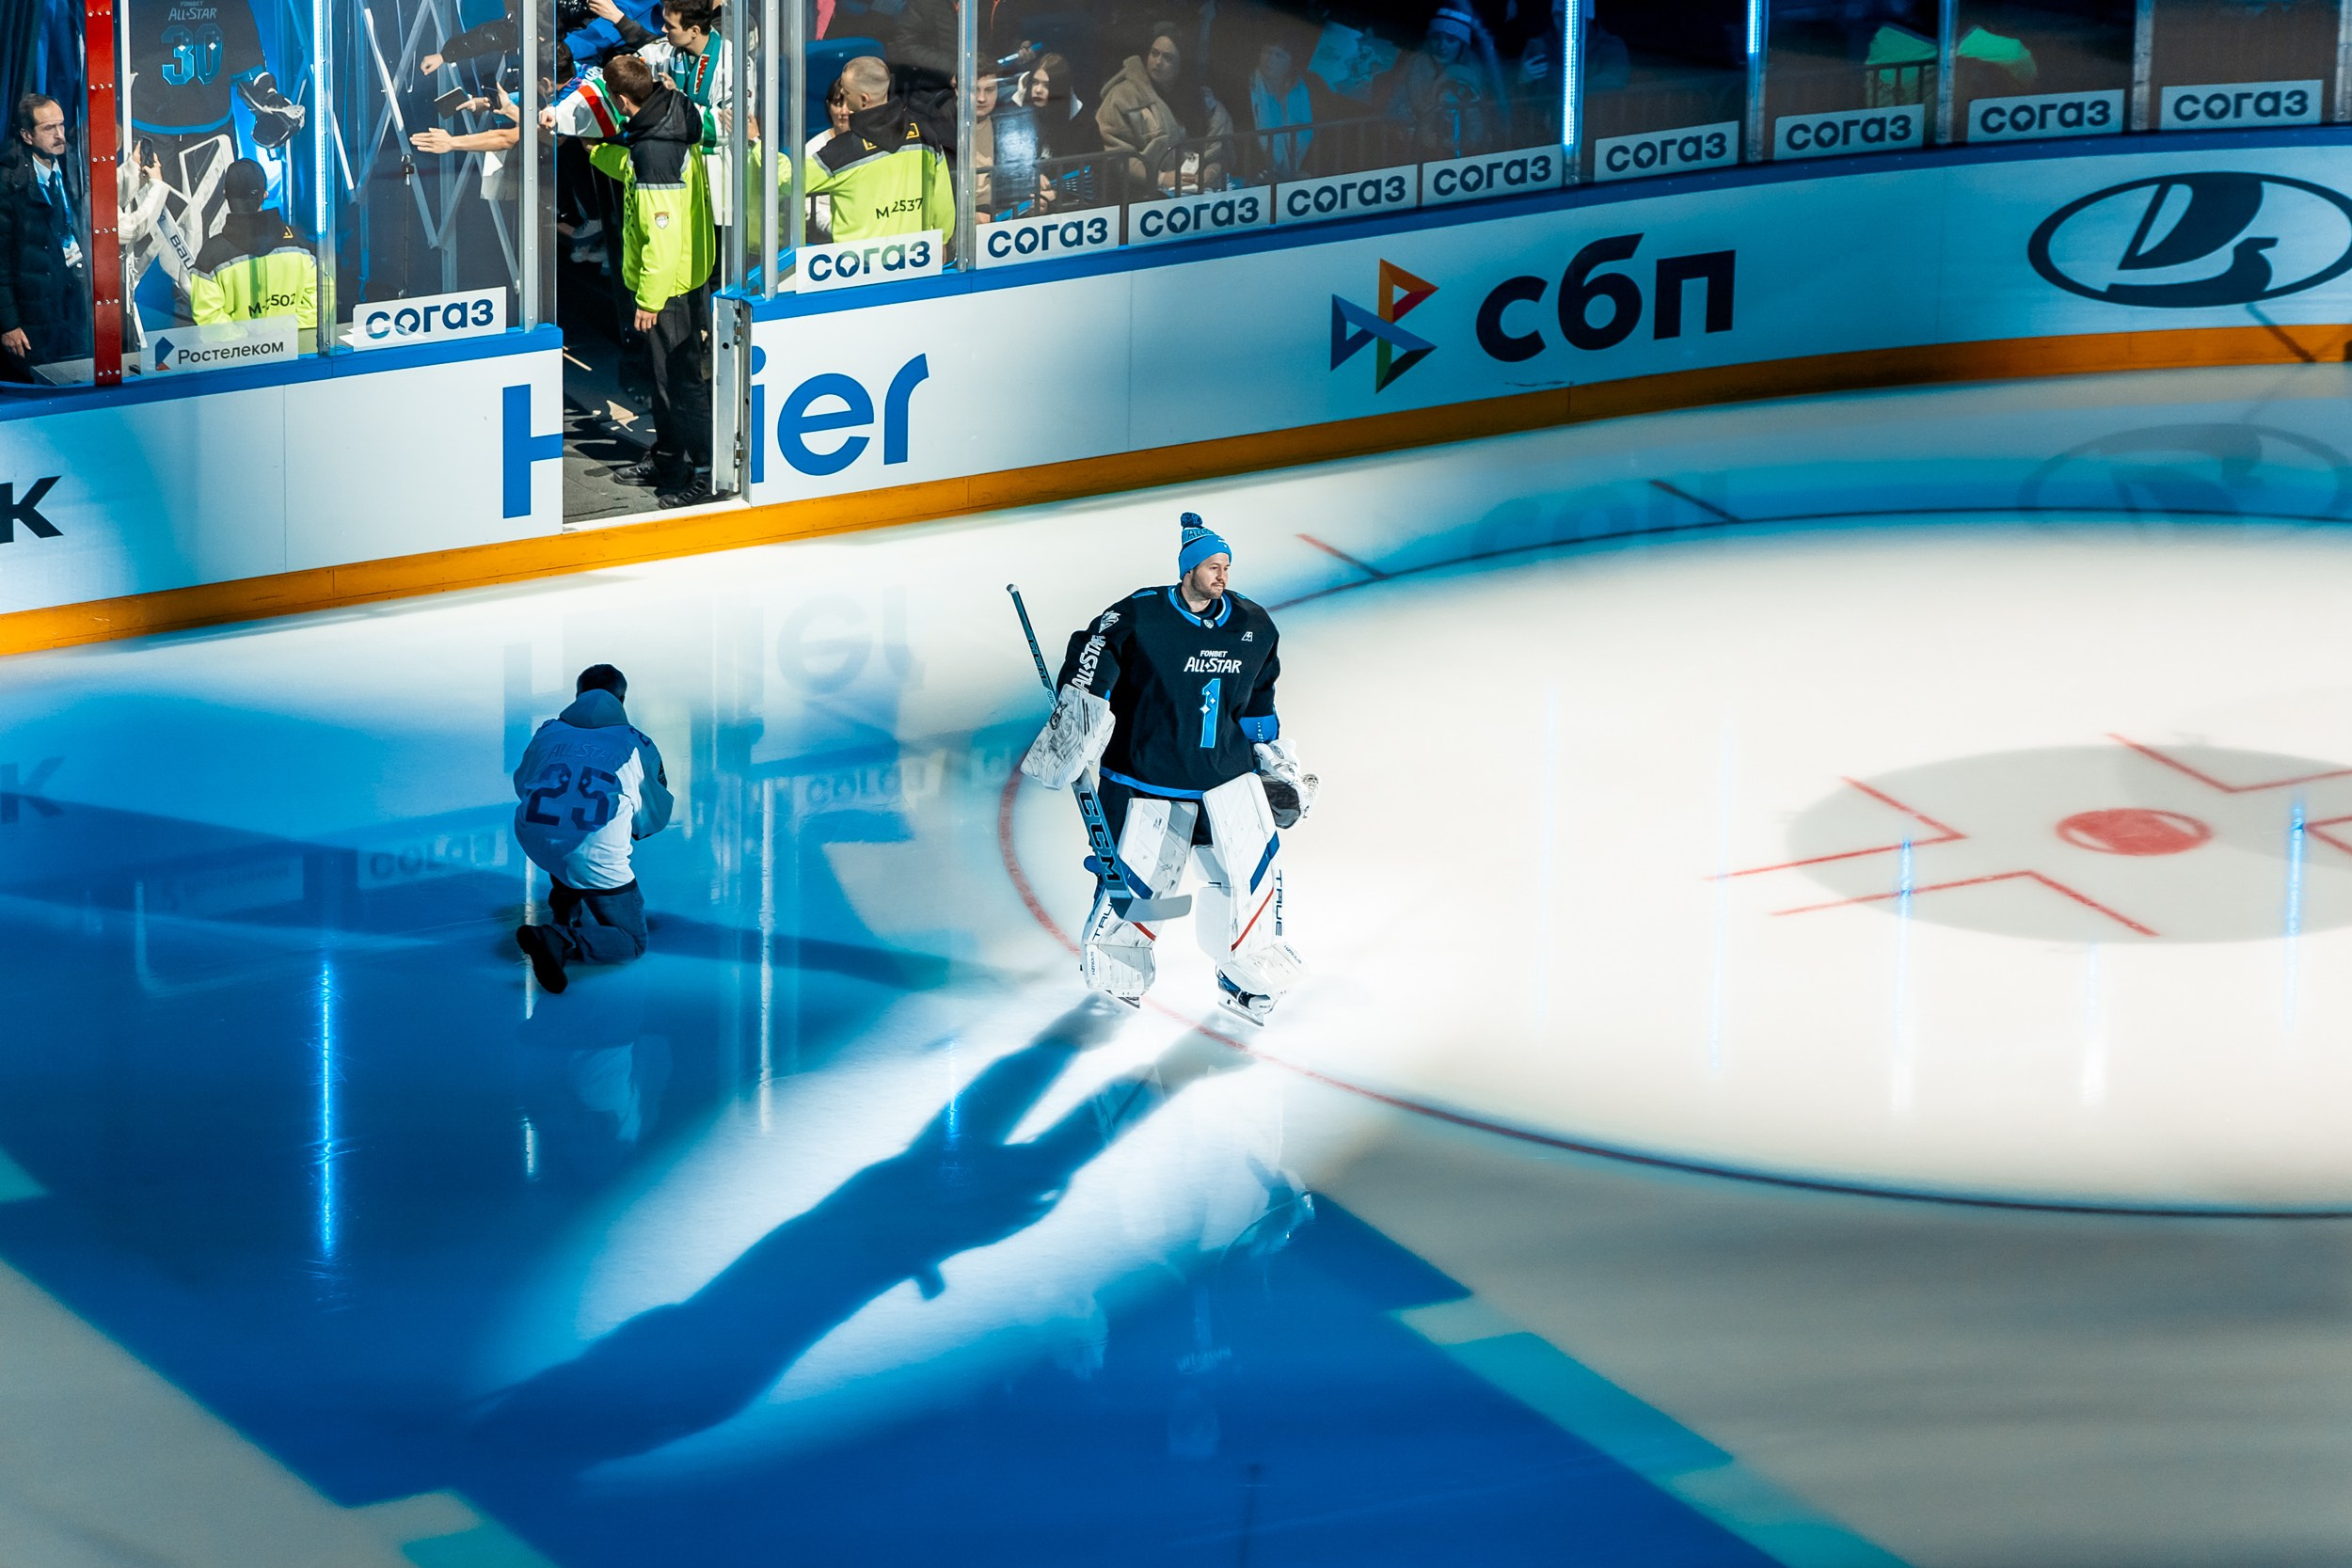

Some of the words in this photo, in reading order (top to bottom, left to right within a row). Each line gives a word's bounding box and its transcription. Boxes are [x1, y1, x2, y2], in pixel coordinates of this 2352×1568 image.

[160, 23, 224, 86] 30
[1979, 100, 2111, 134] согаз
[2174, 90, 2308, 122] согаз
[1606, 132, 1727, 173] согаз
[1786, 114, 1912, 150] согаз
[1286, 176, 1406, 217] согаз
[1433, 155, 1551, 197] согаз
[1139, 196, 1260, 238] согаз
[988, 217, 1108, 259] согаз
[808, 241, 930, 281] согаз
[1475, 232, 1737, 363] сбп
[365, 299, 494, 340] согаз
[178, 341, 284, 364] Ростелеком
[1200, 649, 1228, 658] FONBET
[1200, 677, 1221, 749] 1
[523, 762, 617, 832] 25
[1078, 784, 1123, 883] CCM
[1091, 903, 1113, 942] TRU
[1275, 869, 1283, 937] TRUE
